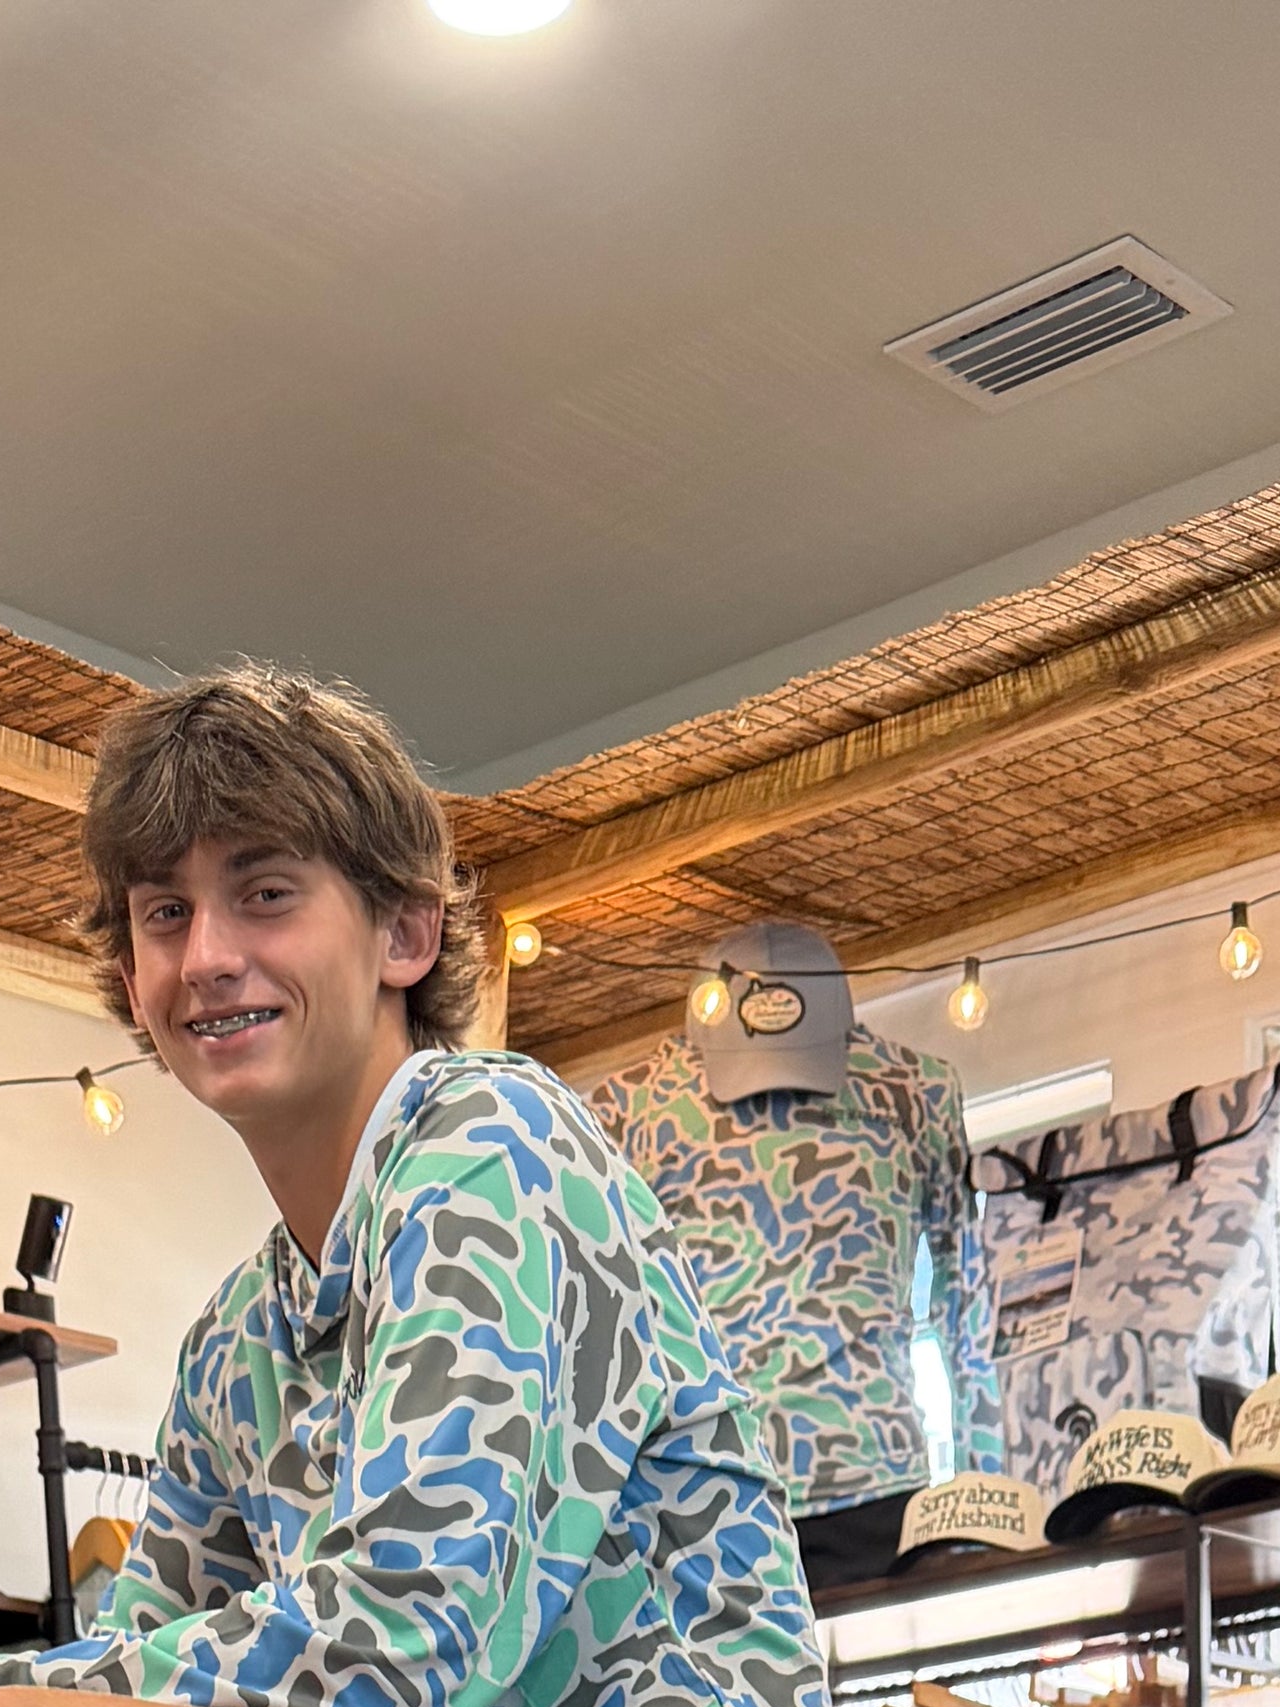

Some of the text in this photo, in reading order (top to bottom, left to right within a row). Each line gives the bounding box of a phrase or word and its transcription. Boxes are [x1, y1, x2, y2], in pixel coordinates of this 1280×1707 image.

[1136, 1451, 1192, 1479] Right
[919, 1482, 1019, 1517] Sorry about
[937, 1507, 1025, 1534] Husband
